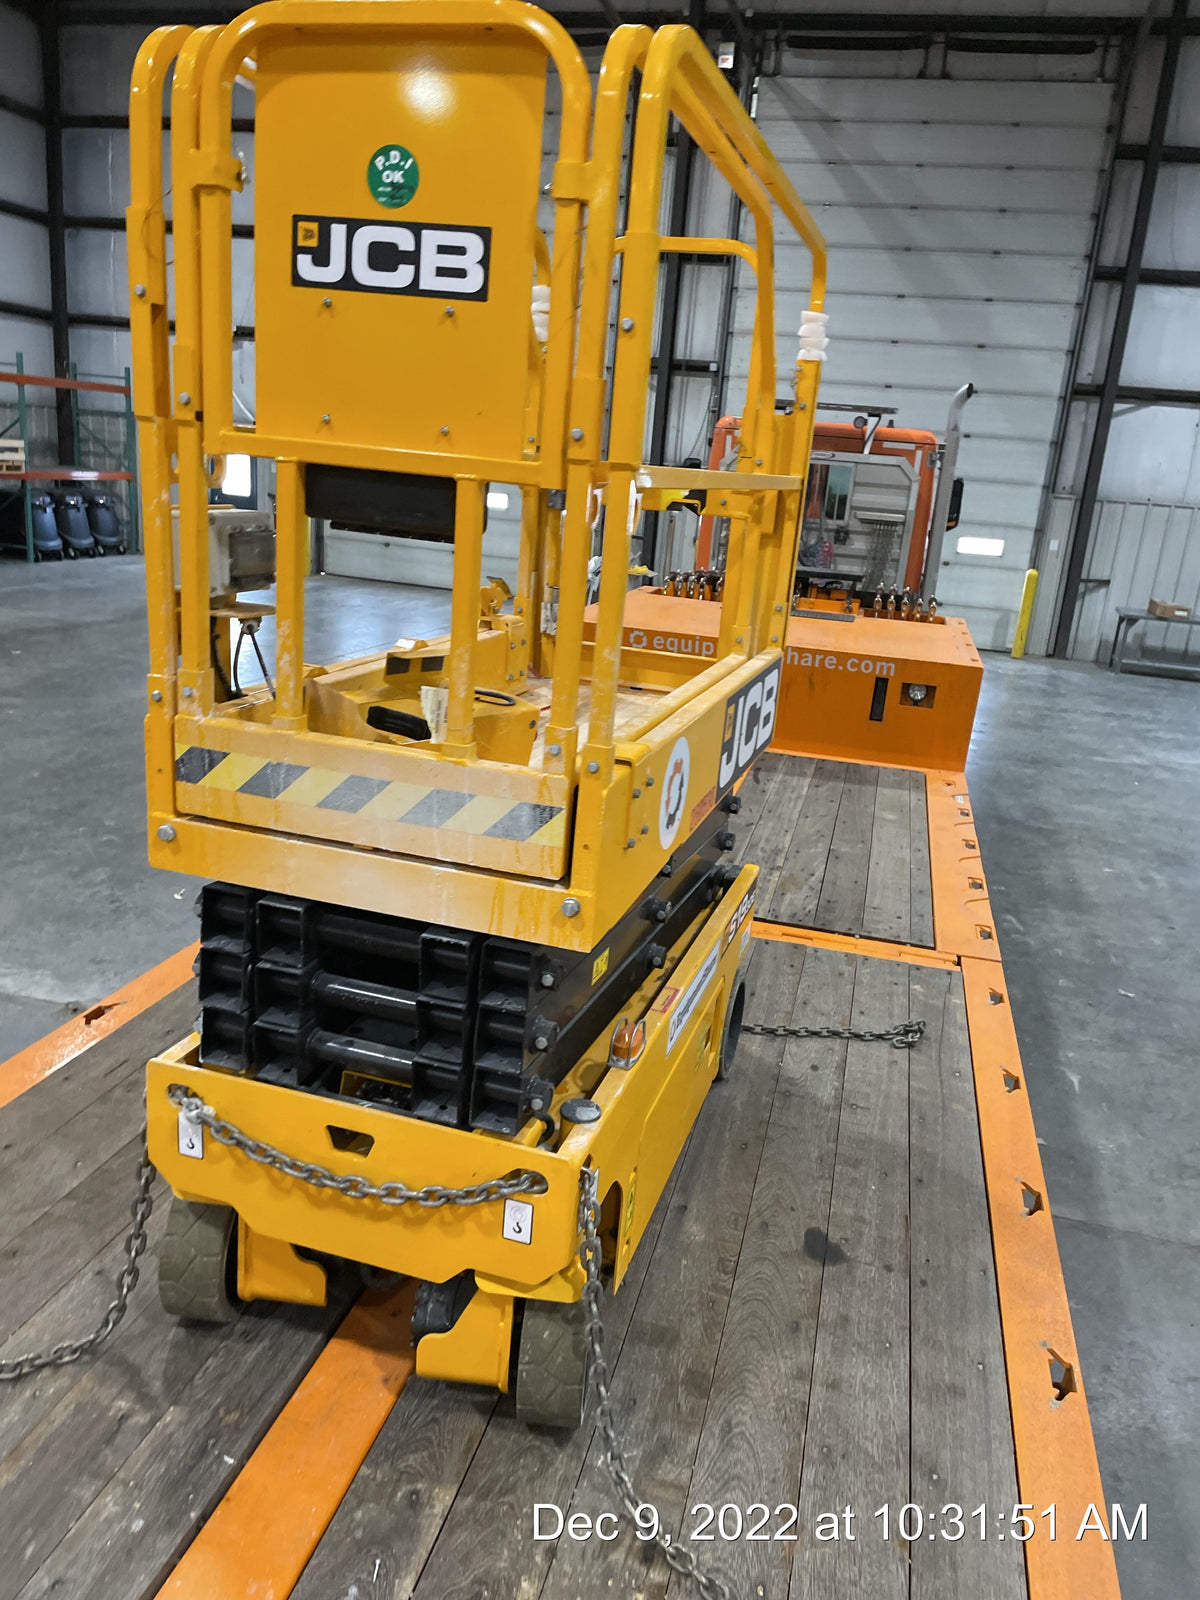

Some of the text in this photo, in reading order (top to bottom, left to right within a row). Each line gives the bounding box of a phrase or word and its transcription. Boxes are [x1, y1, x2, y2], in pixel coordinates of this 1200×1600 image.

[382, 170, 405, 183] OK
[296, 223, 485, 294] JCB
[653, 634, 896, 677] equip hare.com
[719, 668, 779, 788] JCB
